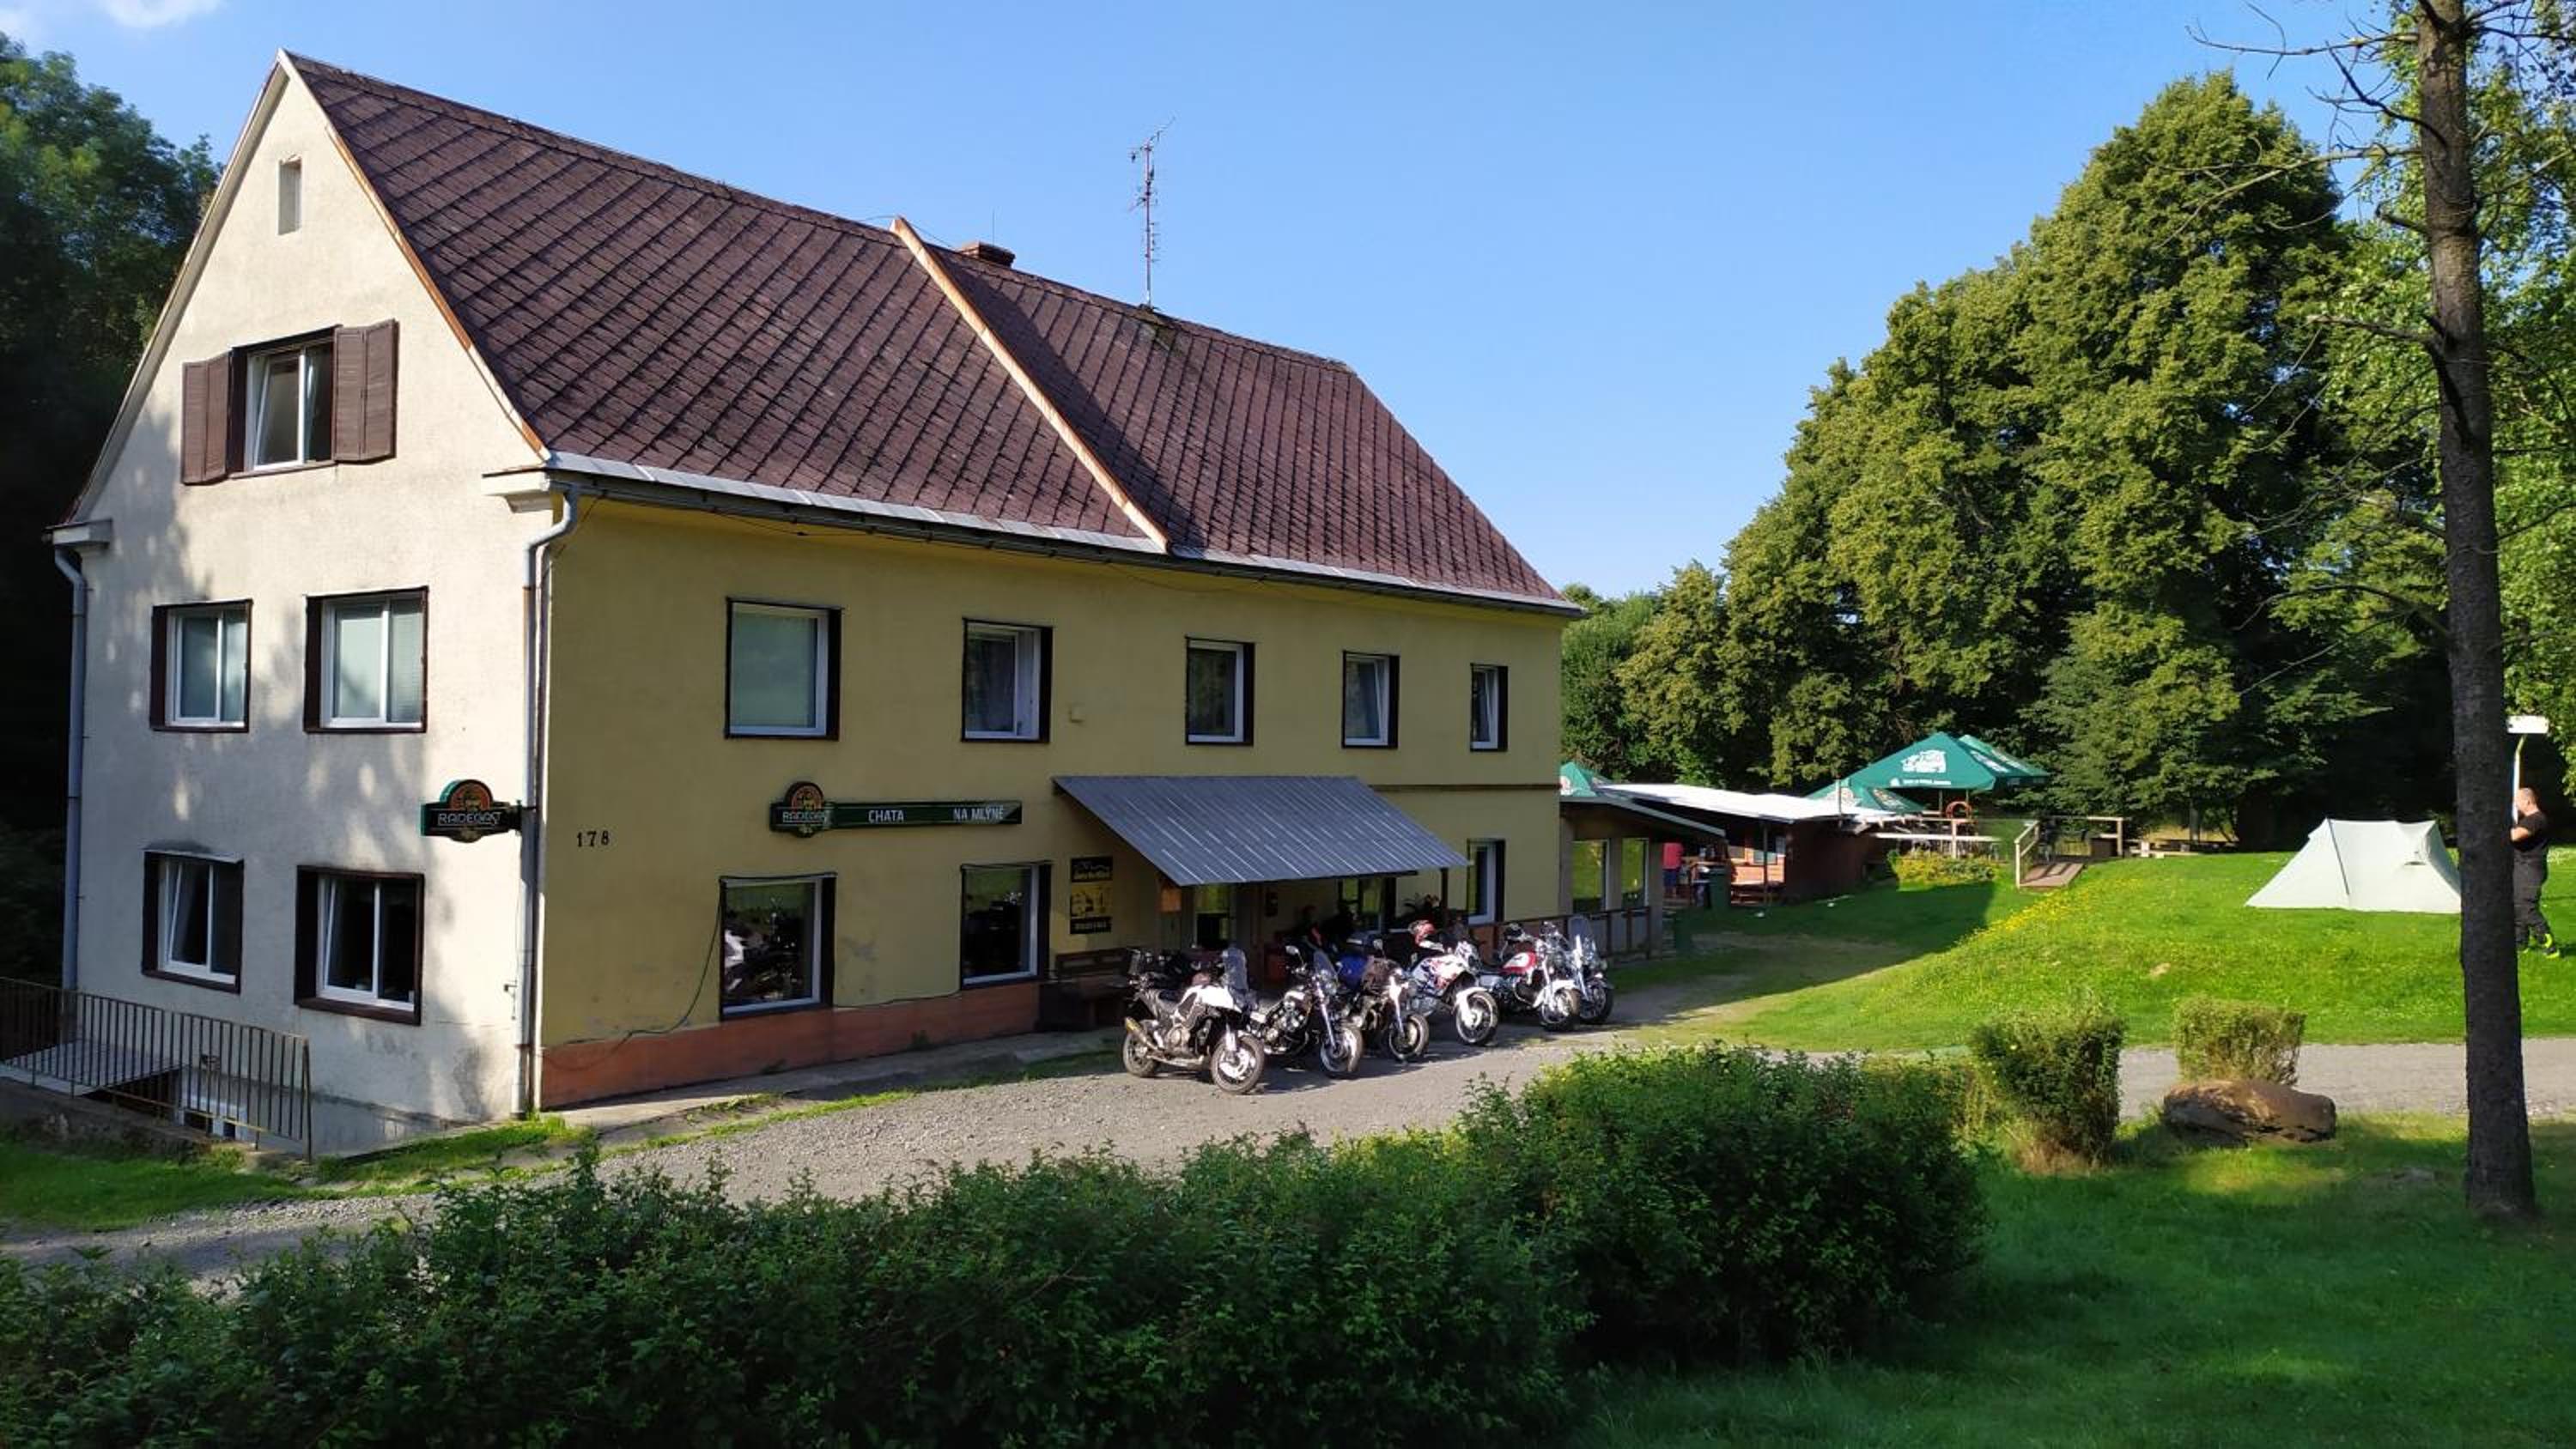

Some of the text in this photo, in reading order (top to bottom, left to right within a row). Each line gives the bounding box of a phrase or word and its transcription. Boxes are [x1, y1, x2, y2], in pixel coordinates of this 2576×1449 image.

[868, 809, 904, 823] CHATA
[953, 808, 968, 821] NA
[577, 830, 610, 847] 178
